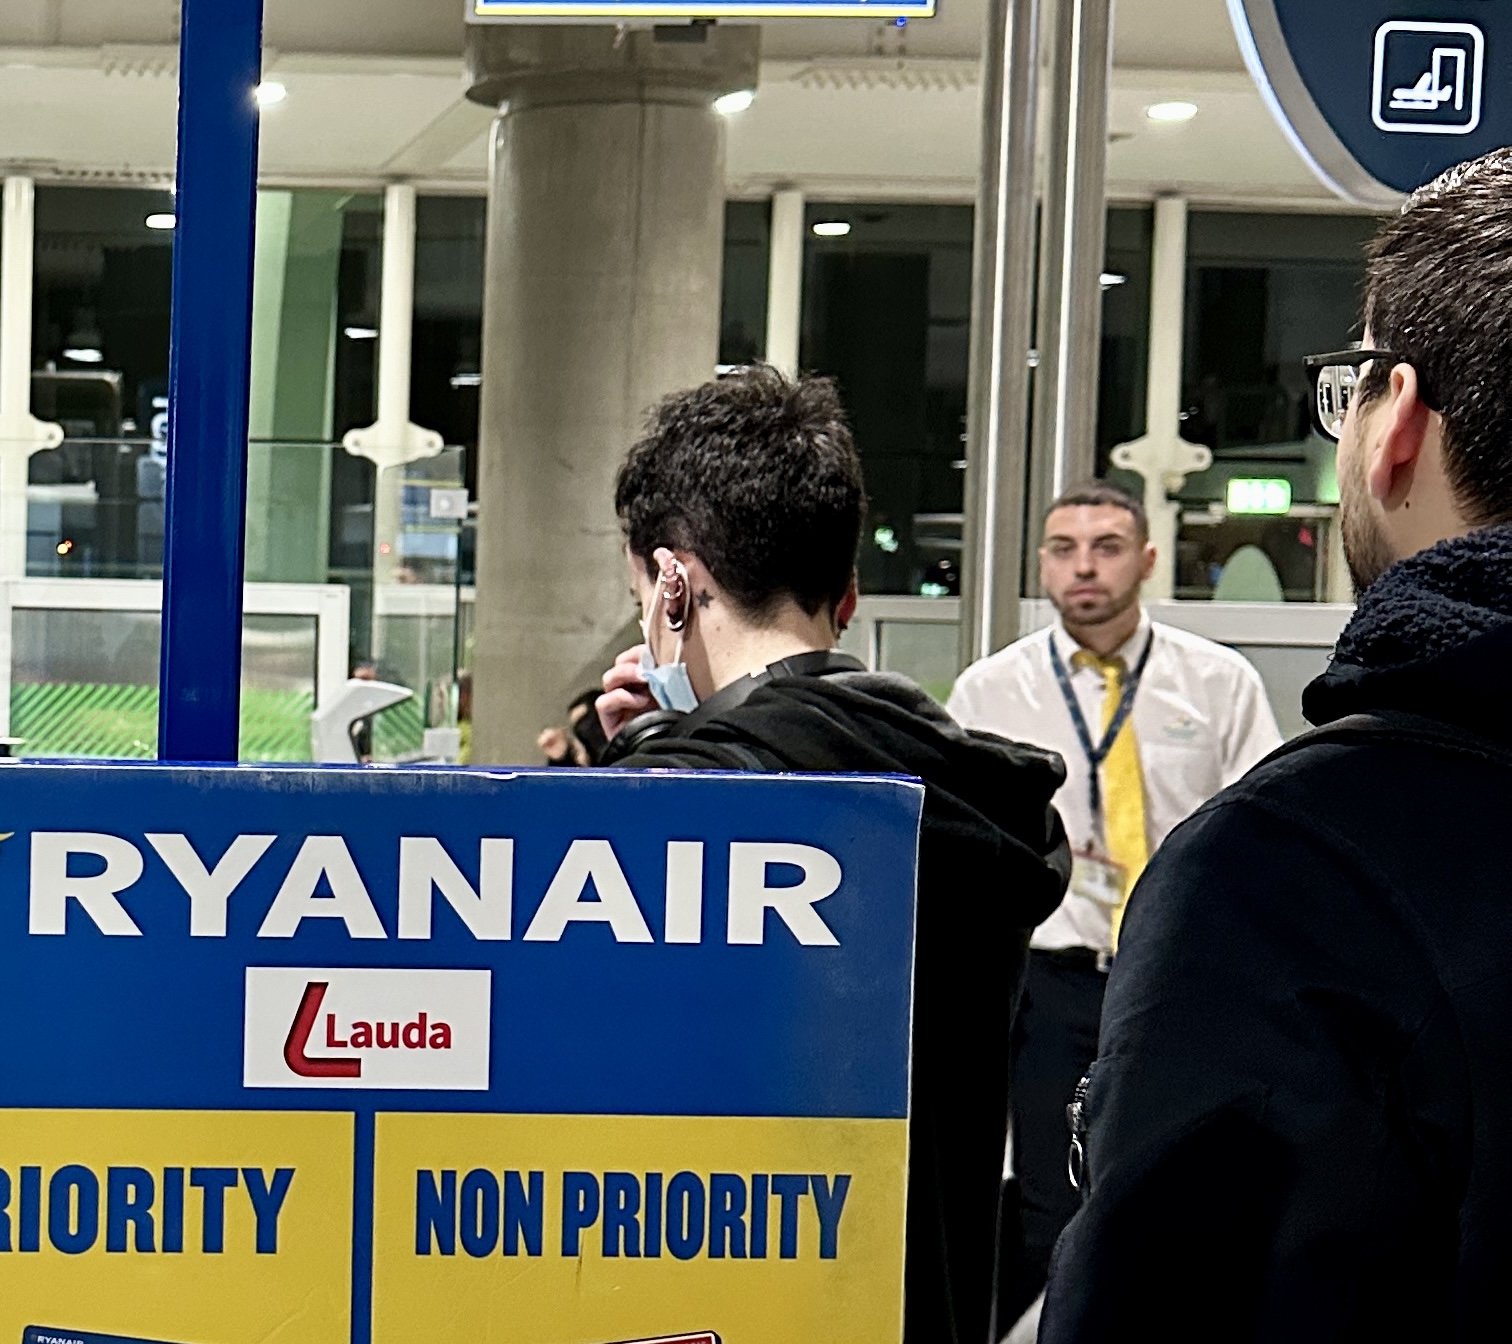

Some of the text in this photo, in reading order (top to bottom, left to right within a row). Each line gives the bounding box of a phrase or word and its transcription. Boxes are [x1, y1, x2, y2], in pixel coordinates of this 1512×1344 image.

[29, 832, 841, 946] RYANAIR
[326, 1012, 451, 1049] Lauda
[416, 1169, 851, 1260] NON PRIORITY
